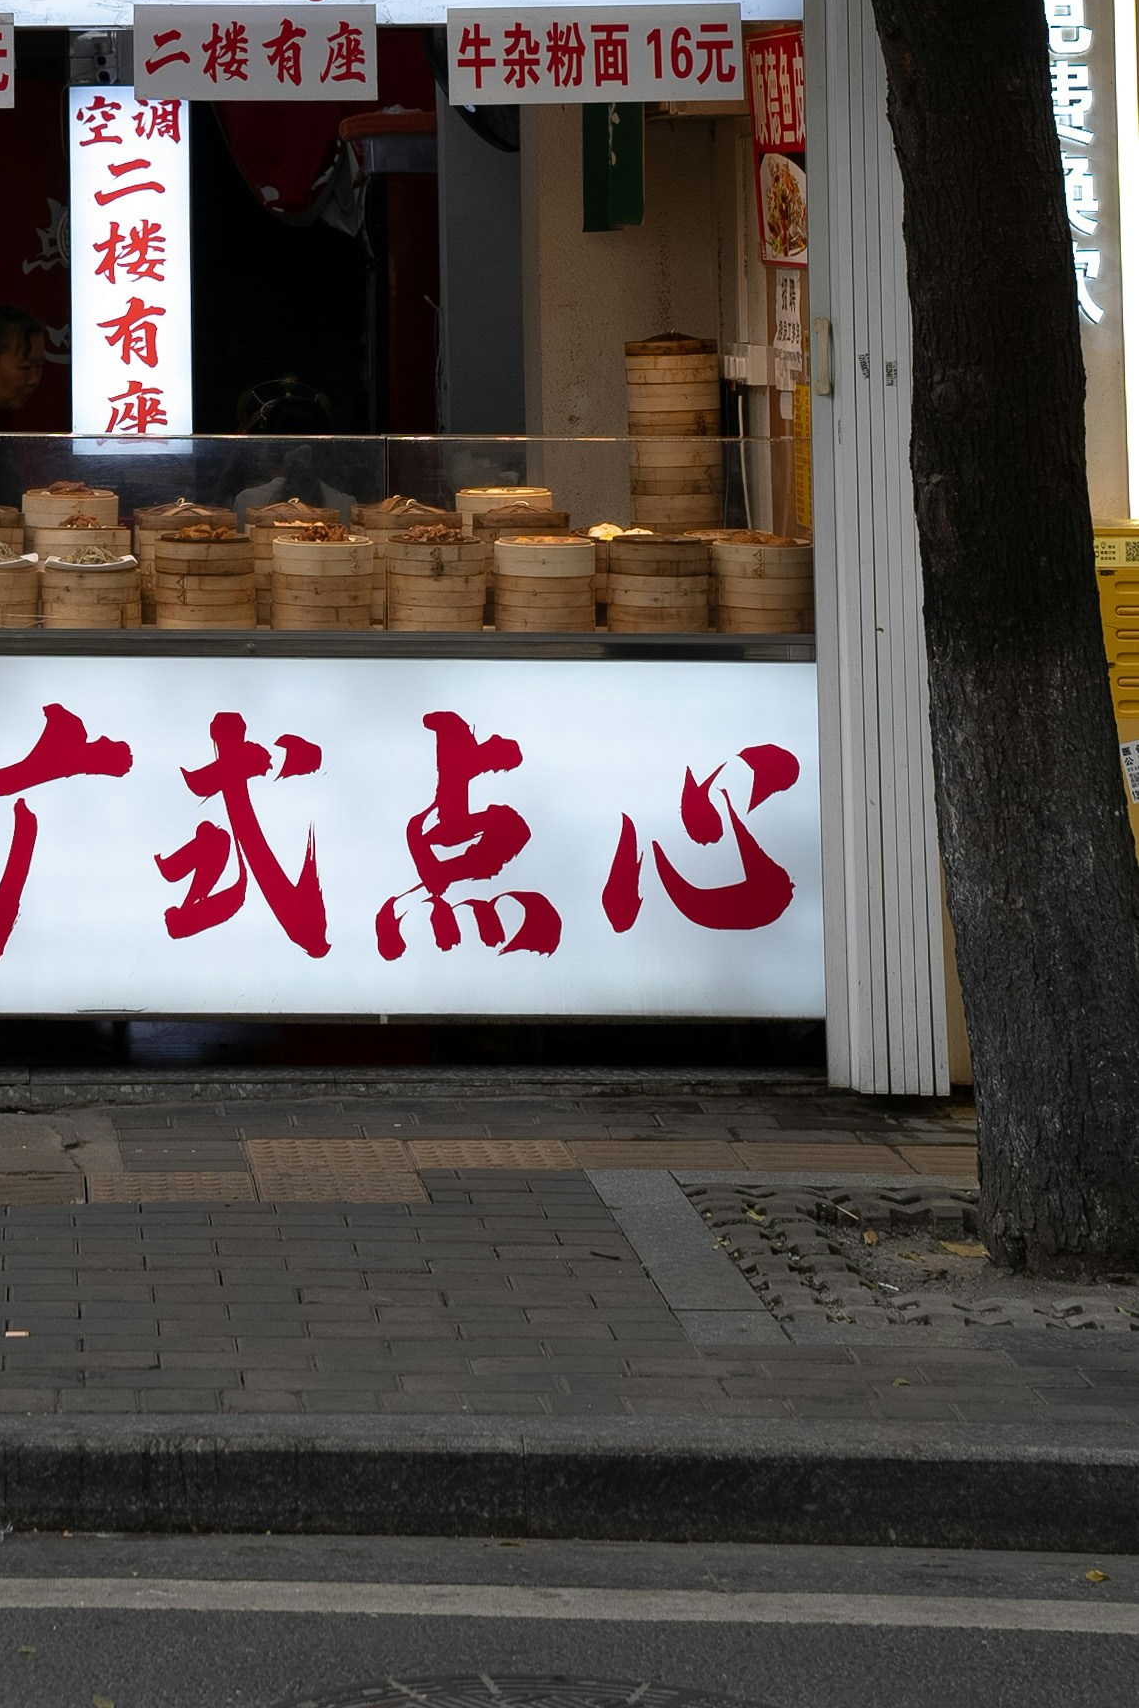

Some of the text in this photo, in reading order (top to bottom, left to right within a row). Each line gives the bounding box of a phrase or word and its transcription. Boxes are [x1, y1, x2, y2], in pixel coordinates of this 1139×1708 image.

[145, 19, 368, 85] 二楼有座
[457, 22, 736, 89] 牛杂粉面 16元
[76, 96, 181, 147] 空调
[93, 158, 168, 434] 二楼有座
